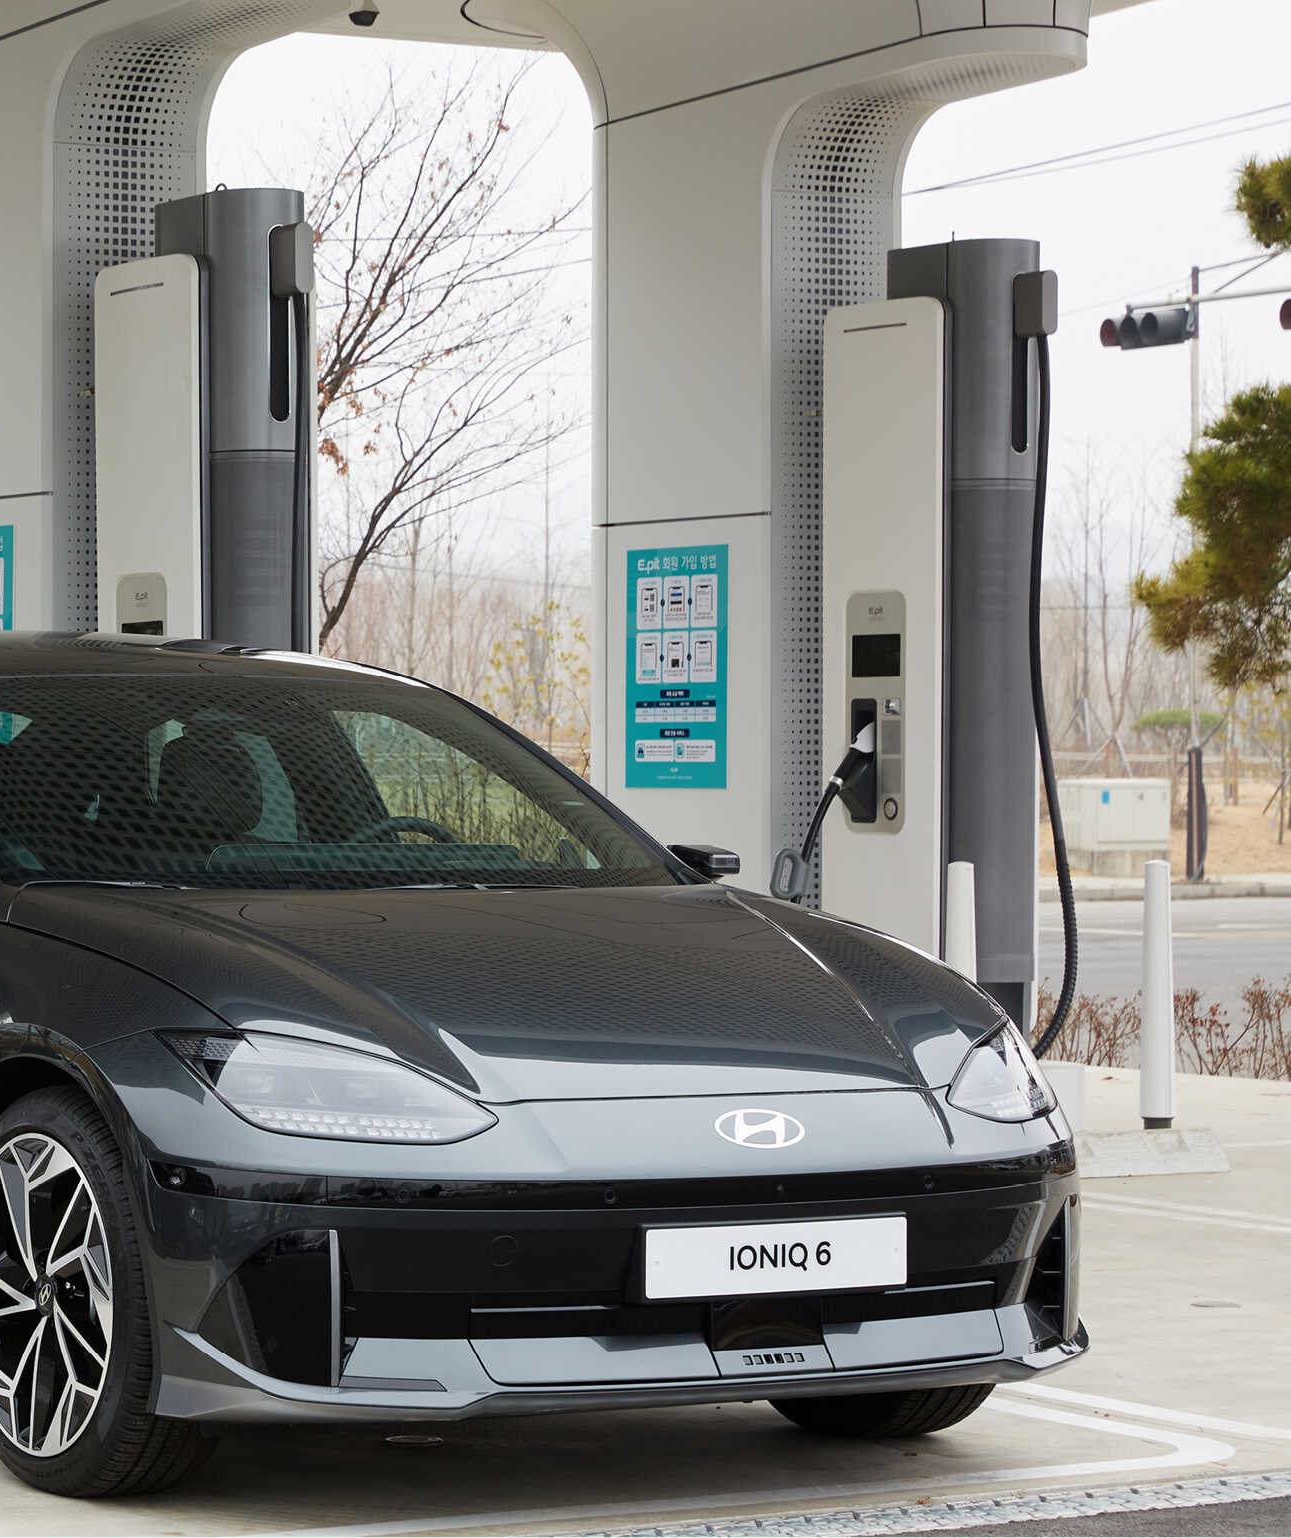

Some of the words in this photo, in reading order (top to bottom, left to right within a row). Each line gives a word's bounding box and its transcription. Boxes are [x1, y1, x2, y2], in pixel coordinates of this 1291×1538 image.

[681, 554, 697, 570] 가입
[729, 1242, 808, 1272] IONIQ
[815, 1241, 832, 1266] 6
